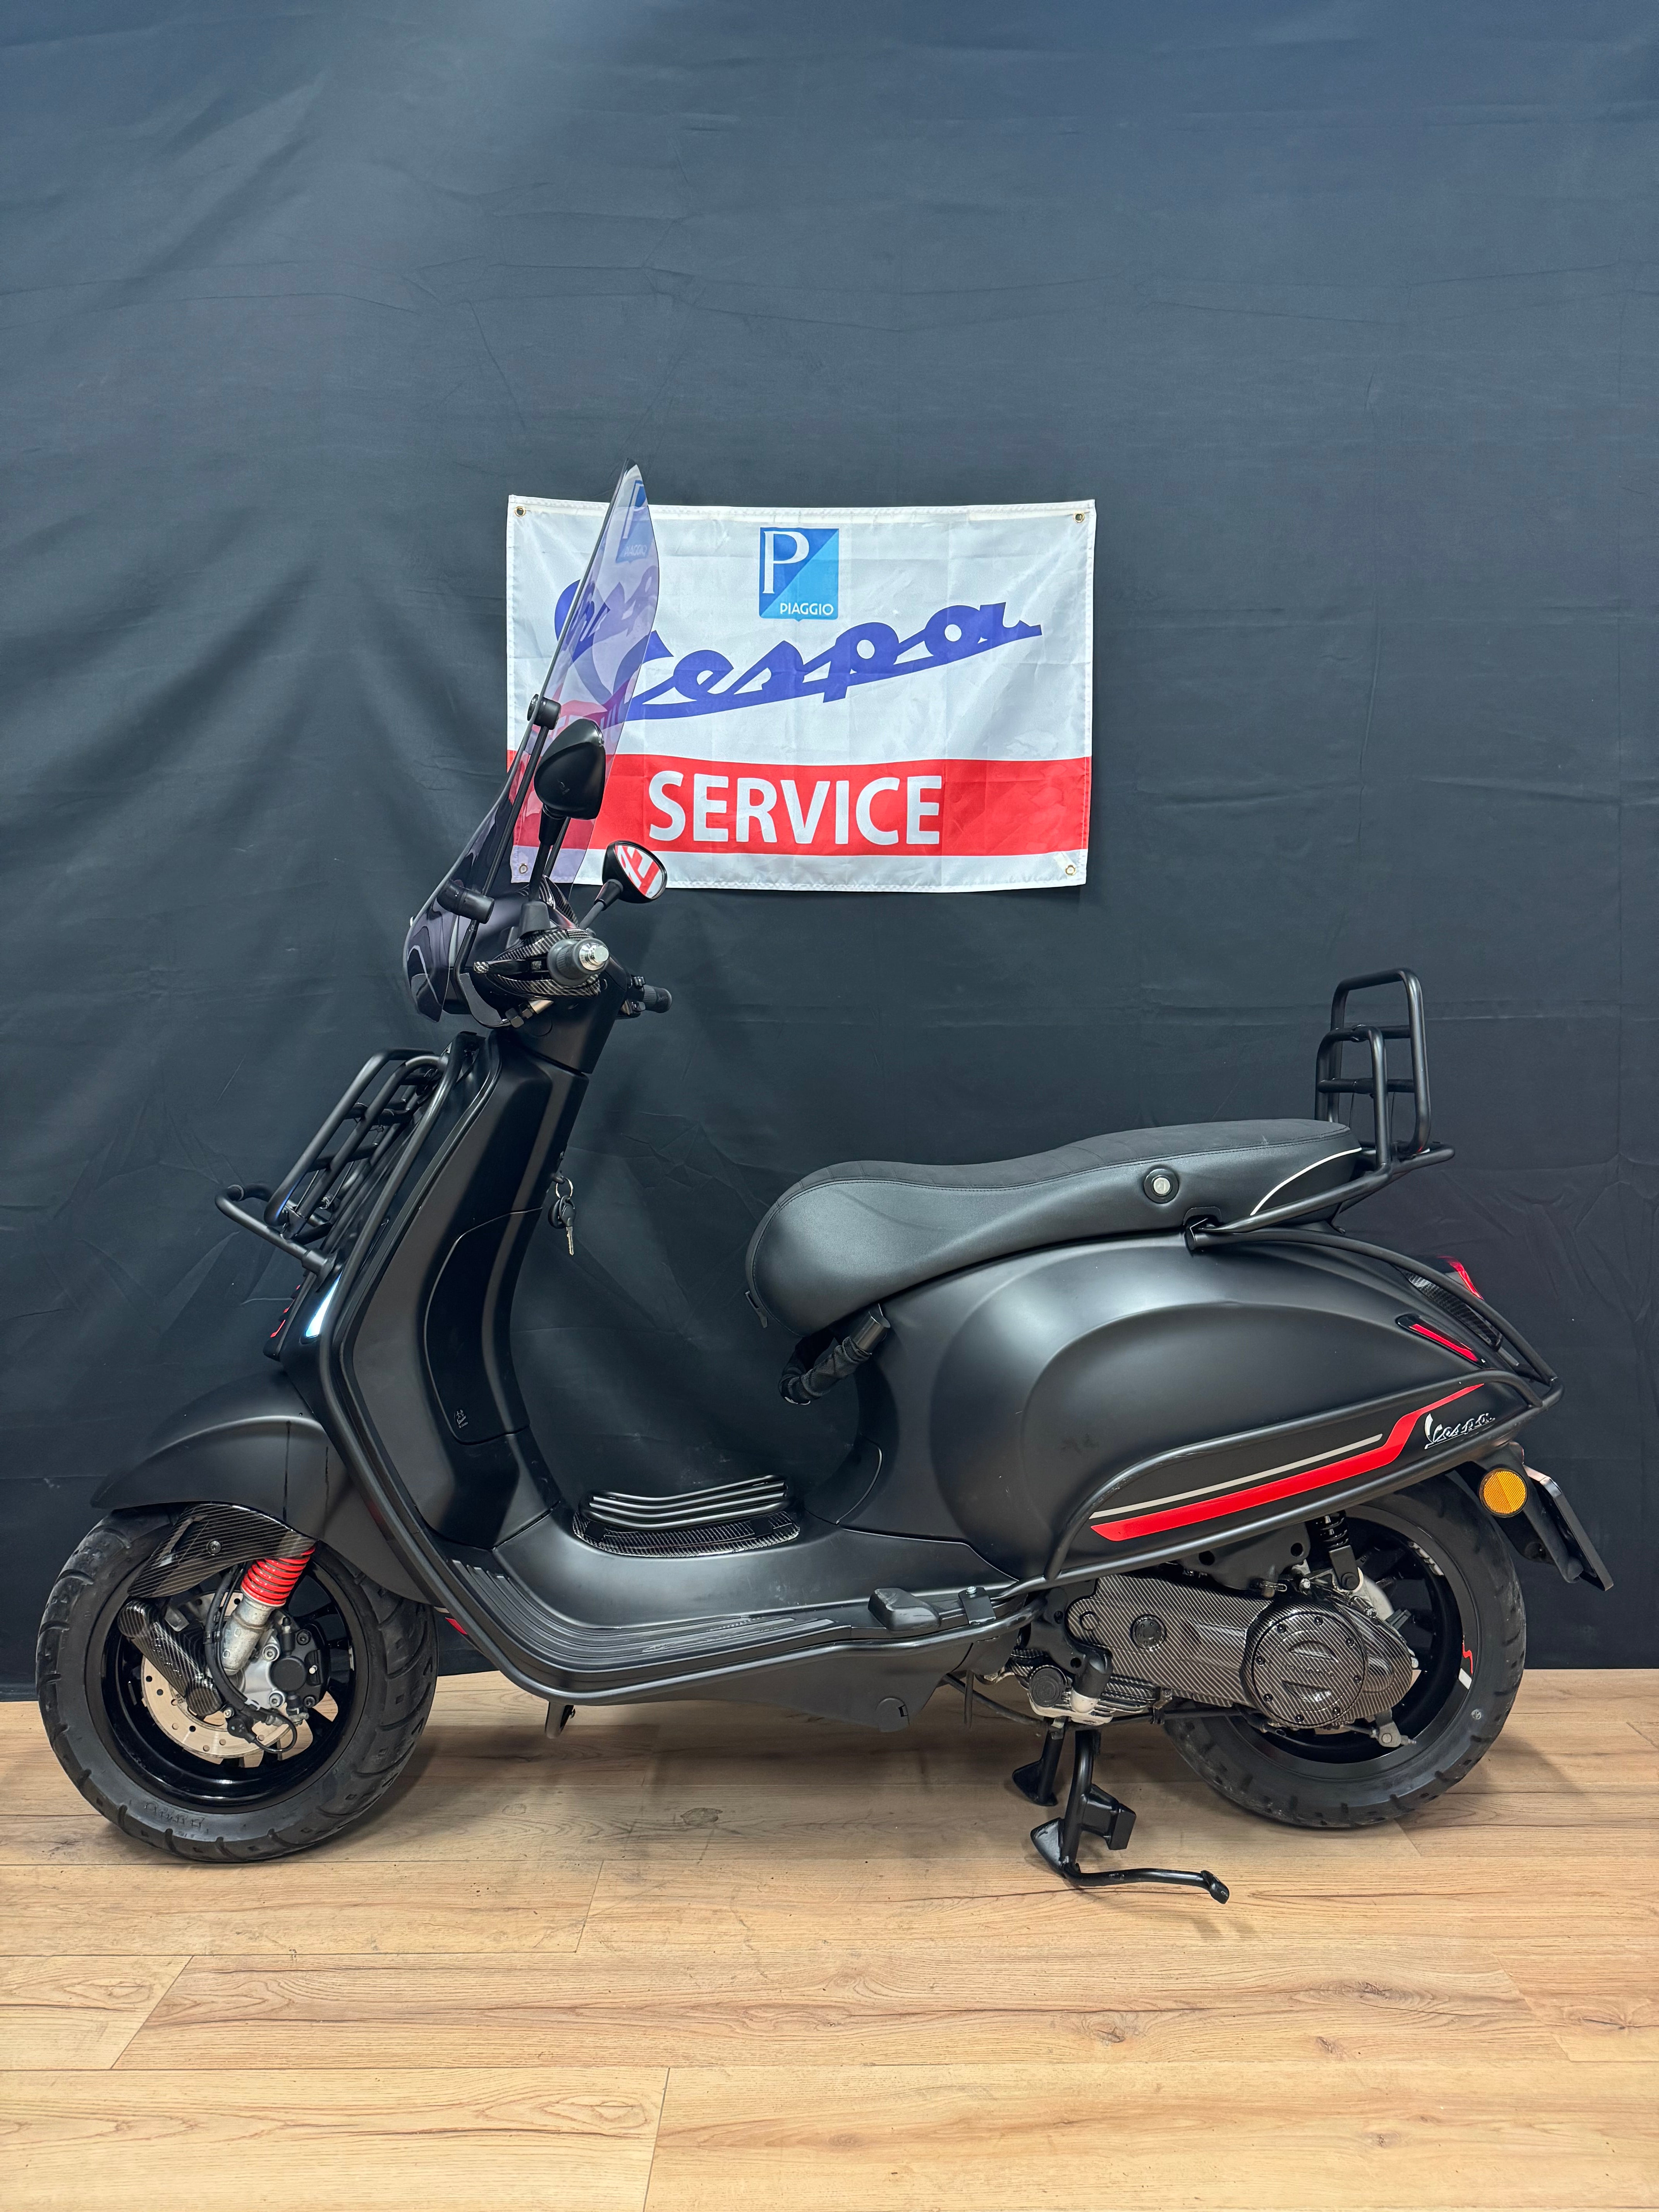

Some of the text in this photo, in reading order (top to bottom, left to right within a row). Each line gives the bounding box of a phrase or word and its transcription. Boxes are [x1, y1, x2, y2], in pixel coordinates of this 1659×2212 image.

[762, 531, 810, 594] P
[780, 602, 834, 616] PIAGGIO
[649, 770, 942, 845] SERVICE
[1424, 1413, 1496, 1449] Vespa
